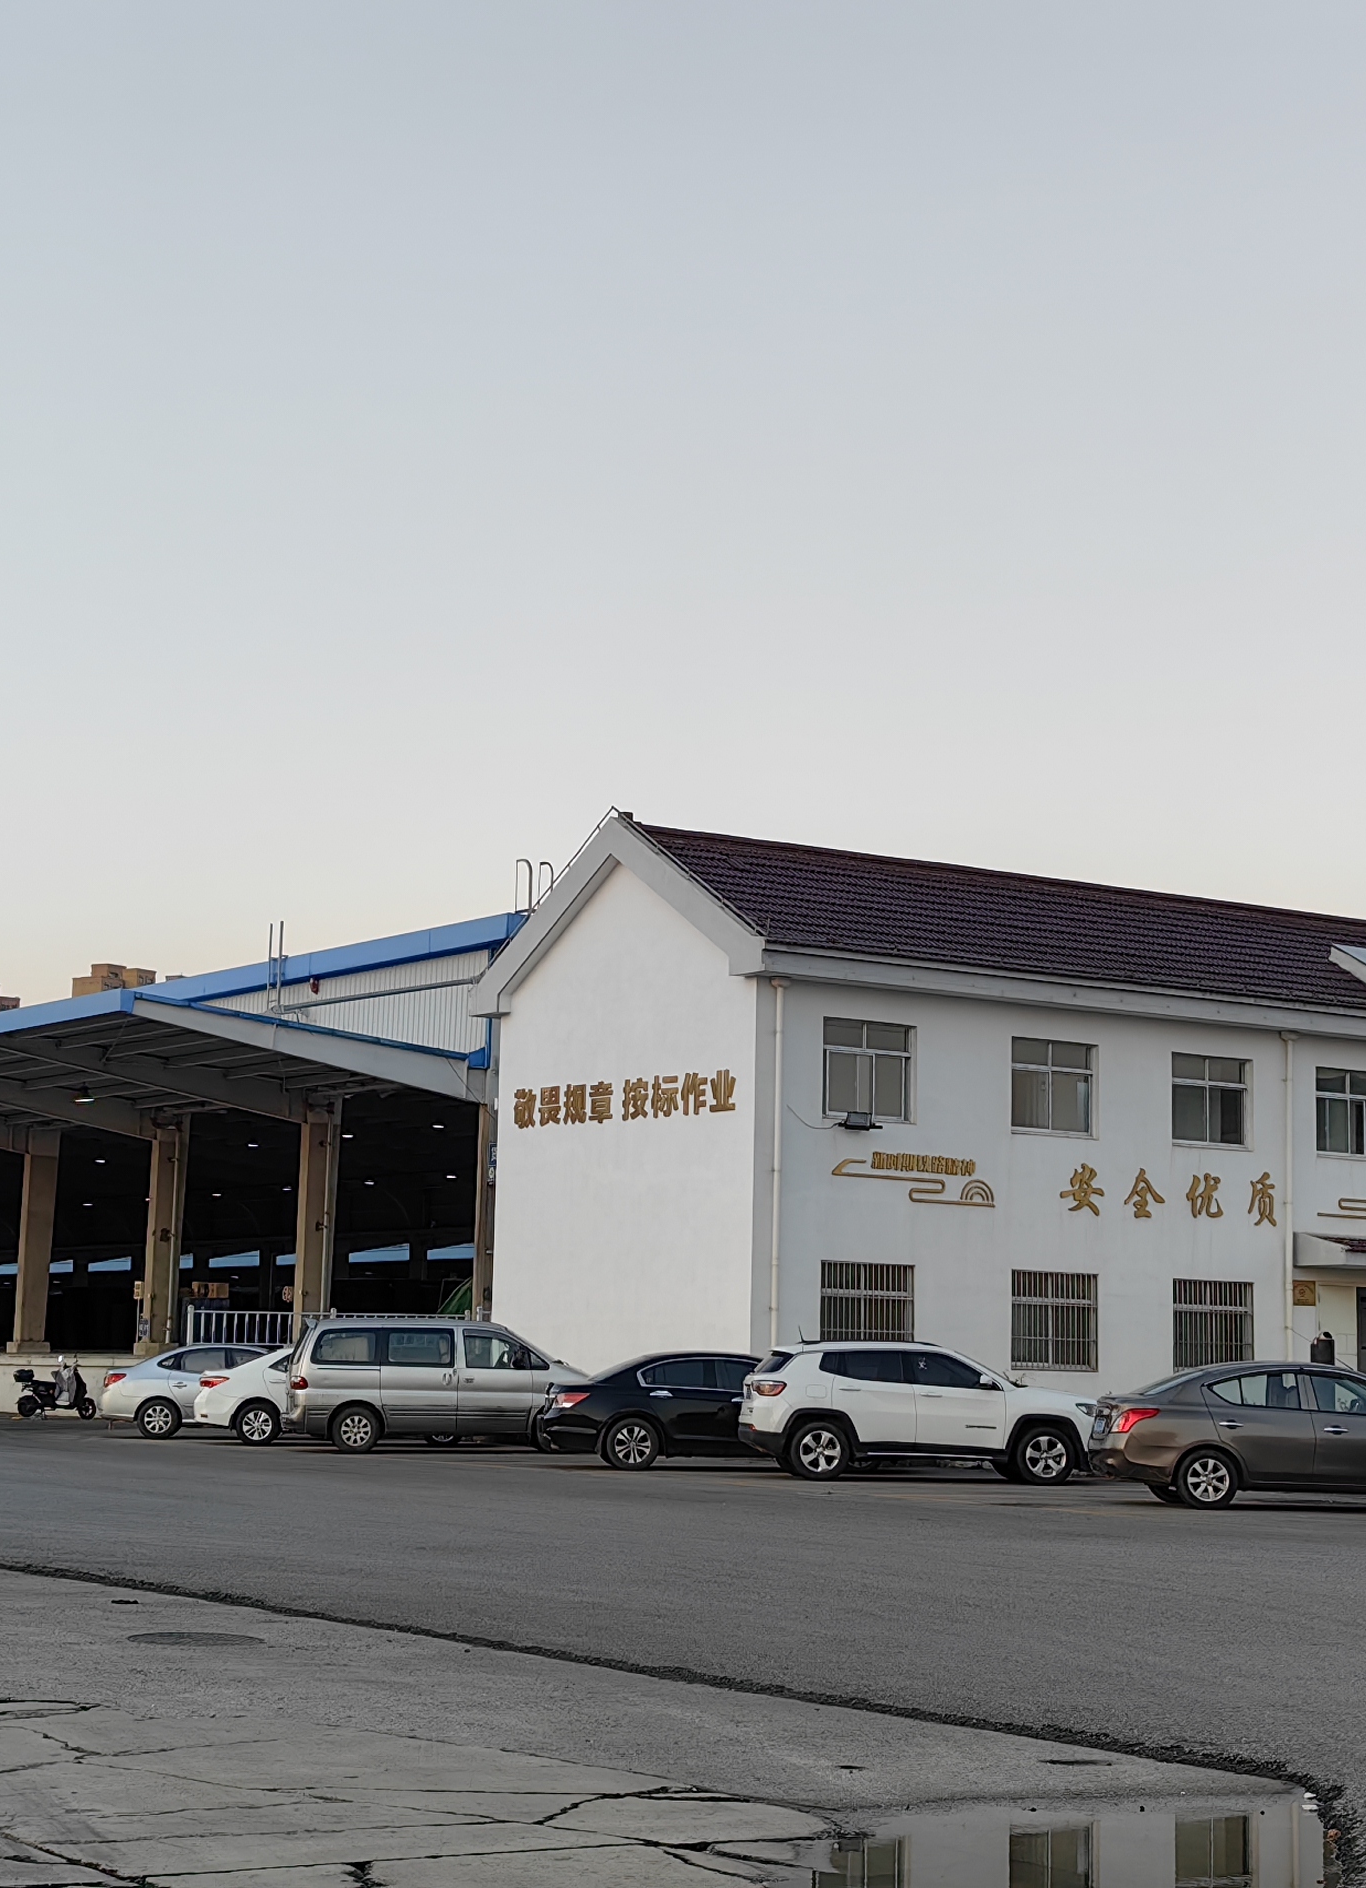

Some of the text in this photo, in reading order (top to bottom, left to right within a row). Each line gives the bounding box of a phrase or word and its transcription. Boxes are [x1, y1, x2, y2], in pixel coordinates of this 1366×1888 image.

[513, 1069, 737, 1129] 敬畏规章 按标作业
[1059, 1163, 1278, 1227] 安全优质
